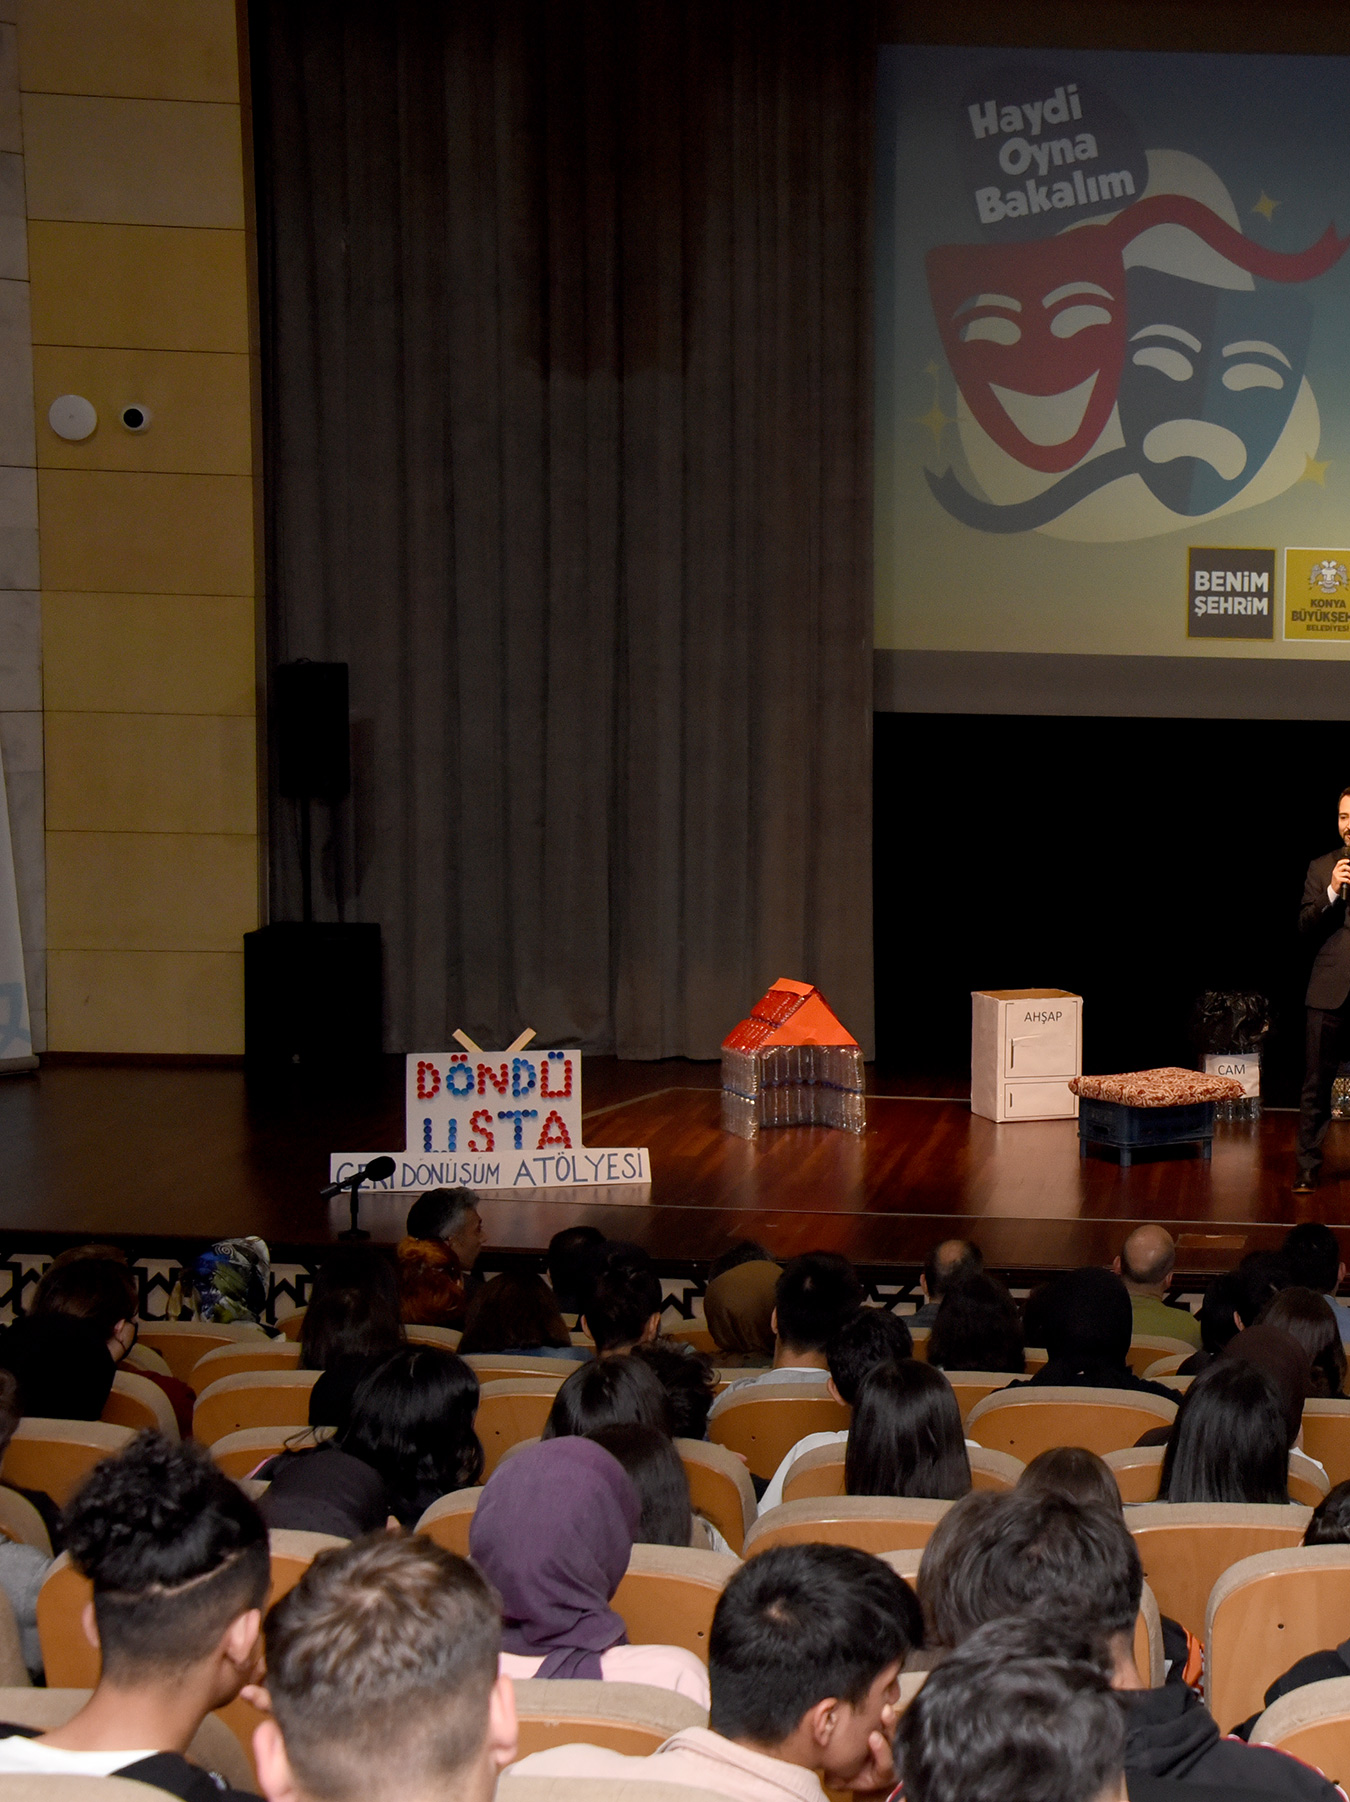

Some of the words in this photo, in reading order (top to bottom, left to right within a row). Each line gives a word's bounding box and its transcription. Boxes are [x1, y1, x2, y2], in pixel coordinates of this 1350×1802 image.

[968, 84, 1083, 140] Haydi
[999, 132, 1098, 177] Oyna
[975, 168, 1136, 224] Bakalım
[1310, 598, 1347, 609] KONYA
[1024, 1010, 1063, 1025] AHŞAP
[417, 1051, 572, 1099] DÖNDÜ
[1217, 1063, 1246, 1076] CAM
